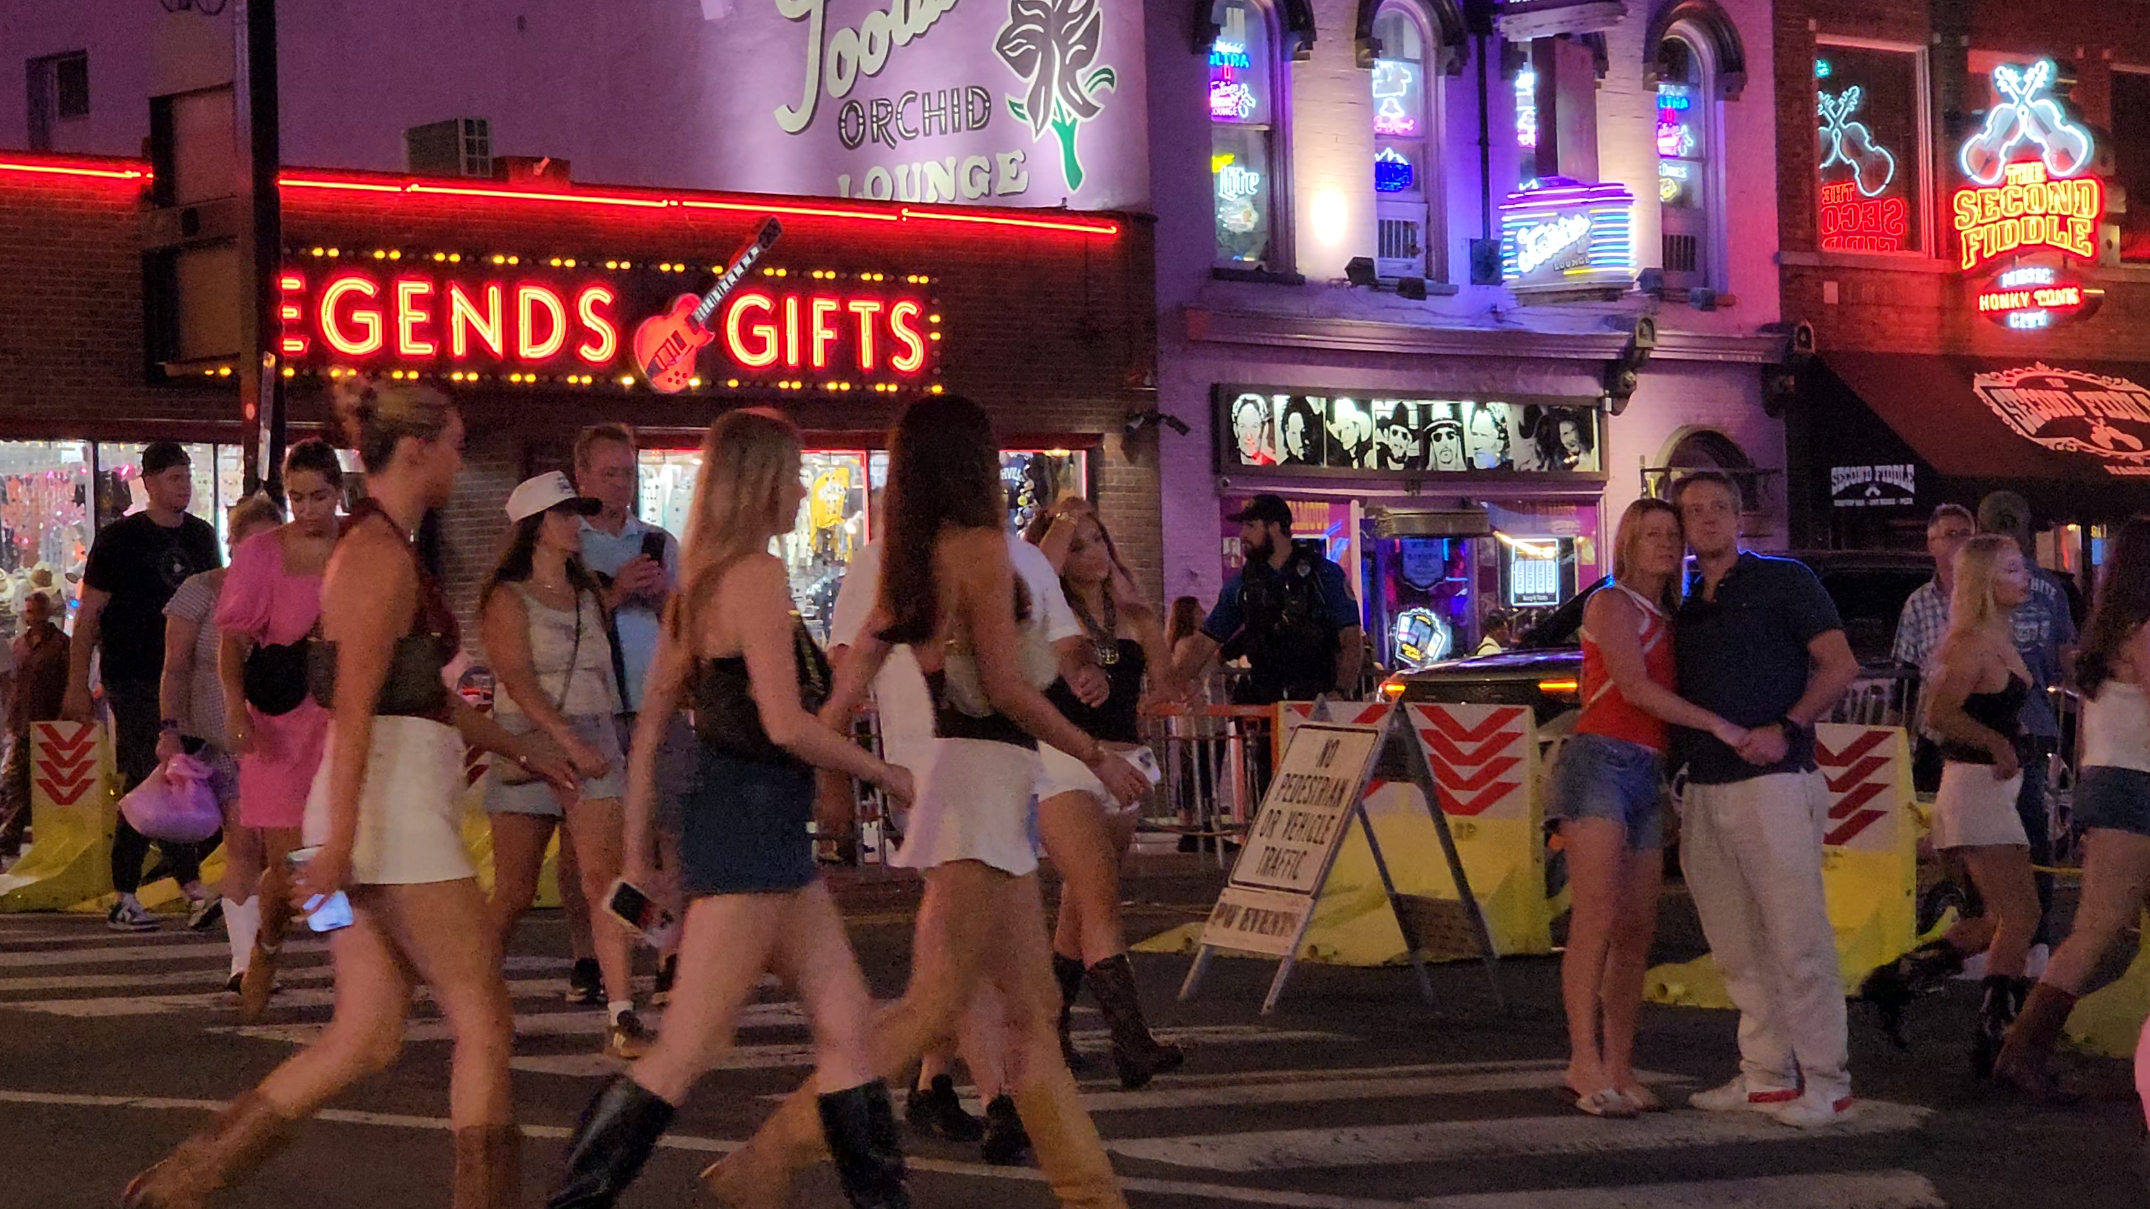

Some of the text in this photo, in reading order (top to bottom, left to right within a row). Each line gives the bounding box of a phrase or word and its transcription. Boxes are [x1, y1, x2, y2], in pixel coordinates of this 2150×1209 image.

[838, 86, 991, 150] ORCHID
[1953, 179, 2098, 230] SECOND
[1961, 215, 2093, 270] FIDDLE
[1978, 288, 2080, 311] HONKY TONK
[724, 291, 926, 372] GIFTS
[1989, 388, 2087, 436] SECOND
[1831, 463, 1916, 496] SECOND FIDDLE
[1316, 738, 1341, 770] NO
[1275, 773, 1351, 808] PEDESTRIAN
[1259, 808, 1336, 846] OR VEHICLE
[1255, 845, 1308, 881] TRAFFIC
